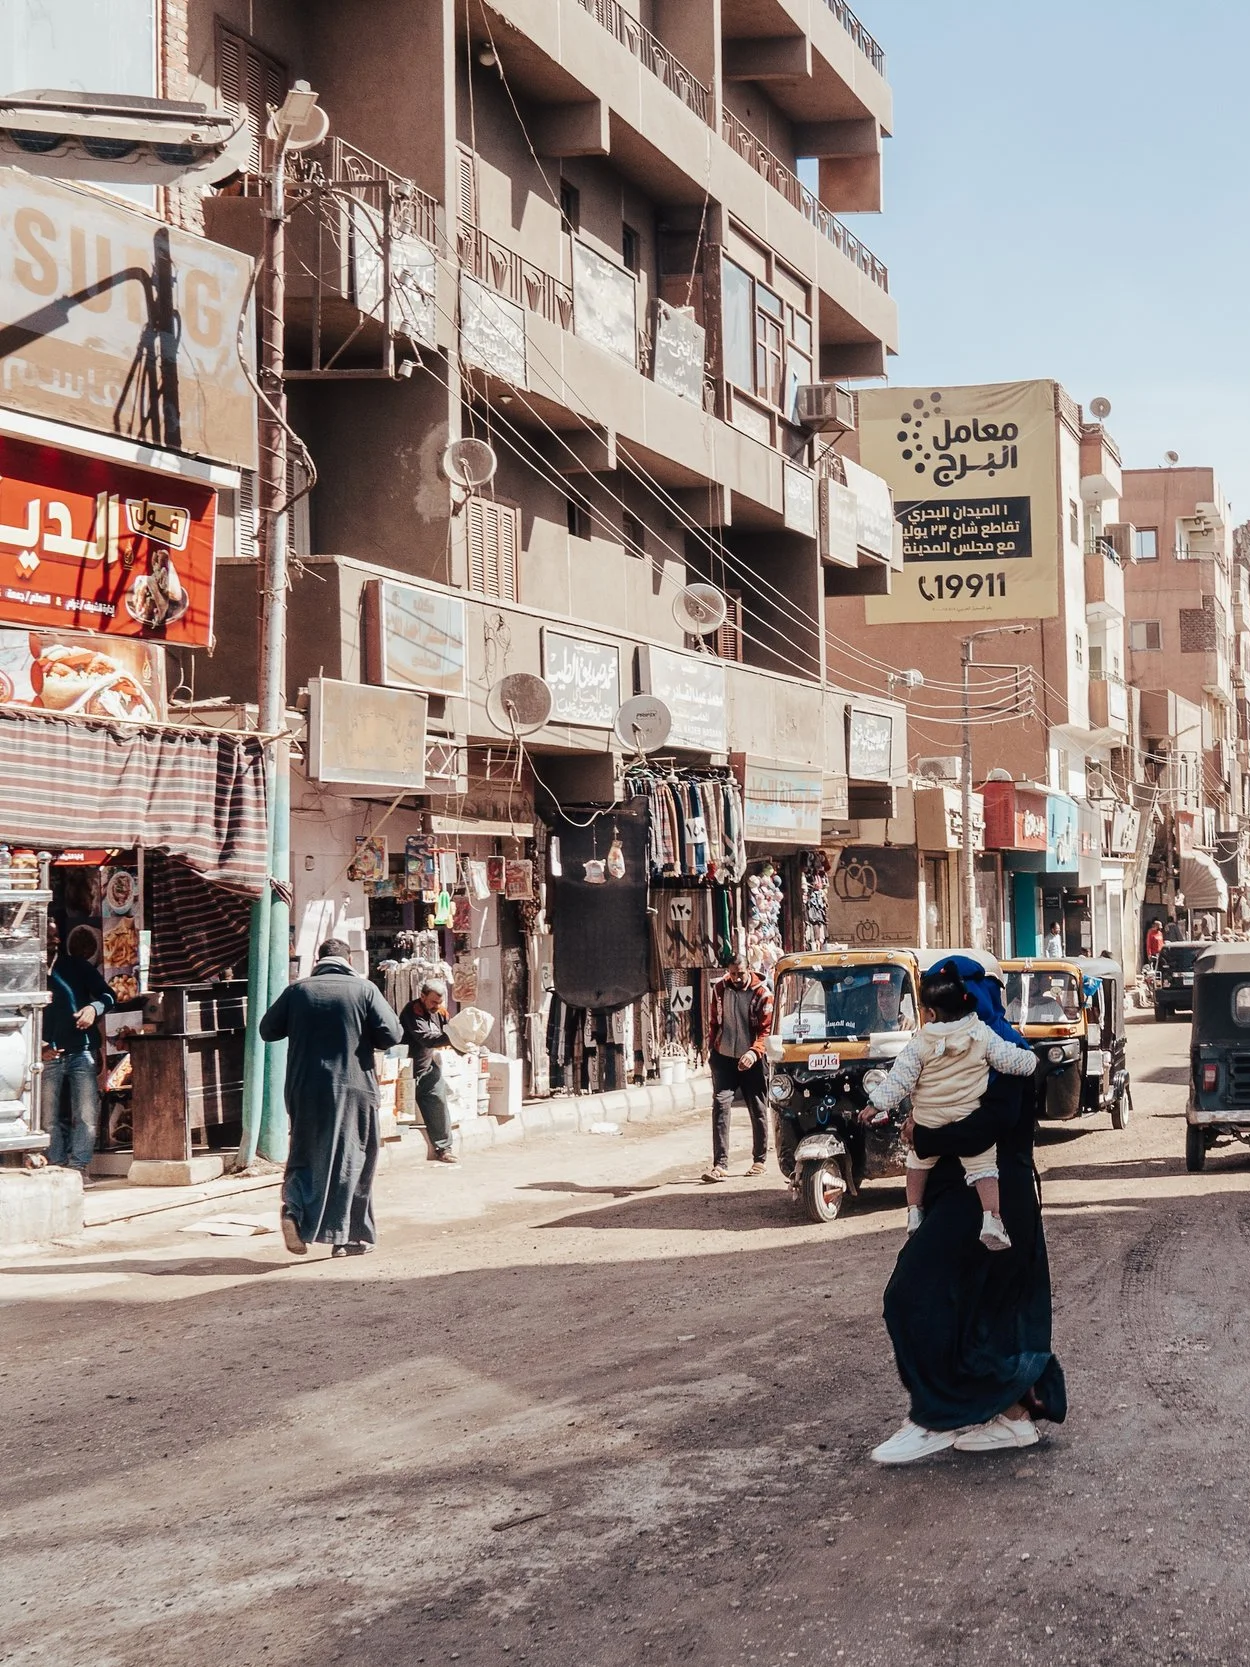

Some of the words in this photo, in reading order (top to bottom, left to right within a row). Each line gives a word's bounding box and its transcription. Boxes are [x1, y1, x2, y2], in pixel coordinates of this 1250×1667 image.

[932, 418, 1018, 451] معامل
[933, 445, 1017, 487] البرج
[135, 498, 179, 537] فول
[907, 506, 949, 524] البحري
[953, 504, 1000, 519] الميدان
[0, 490, 120, 572] الدي
[902, 524, 928, 539] يولي
[930, 524, 947, 536] ٢٣
[949, 521, 978, 540] شارع
[980, 521, 1020, 537] تقاطع
[903, 542, 950, 555] المدينة
[953, 542, 994, 556] مجلس
[996, 541, 1016, 555] مع
[933, 572, 1006, 600] 19911
[671, 989, 692, 1006] ٨٠
[810, 1054, 838, 1069] فارس
